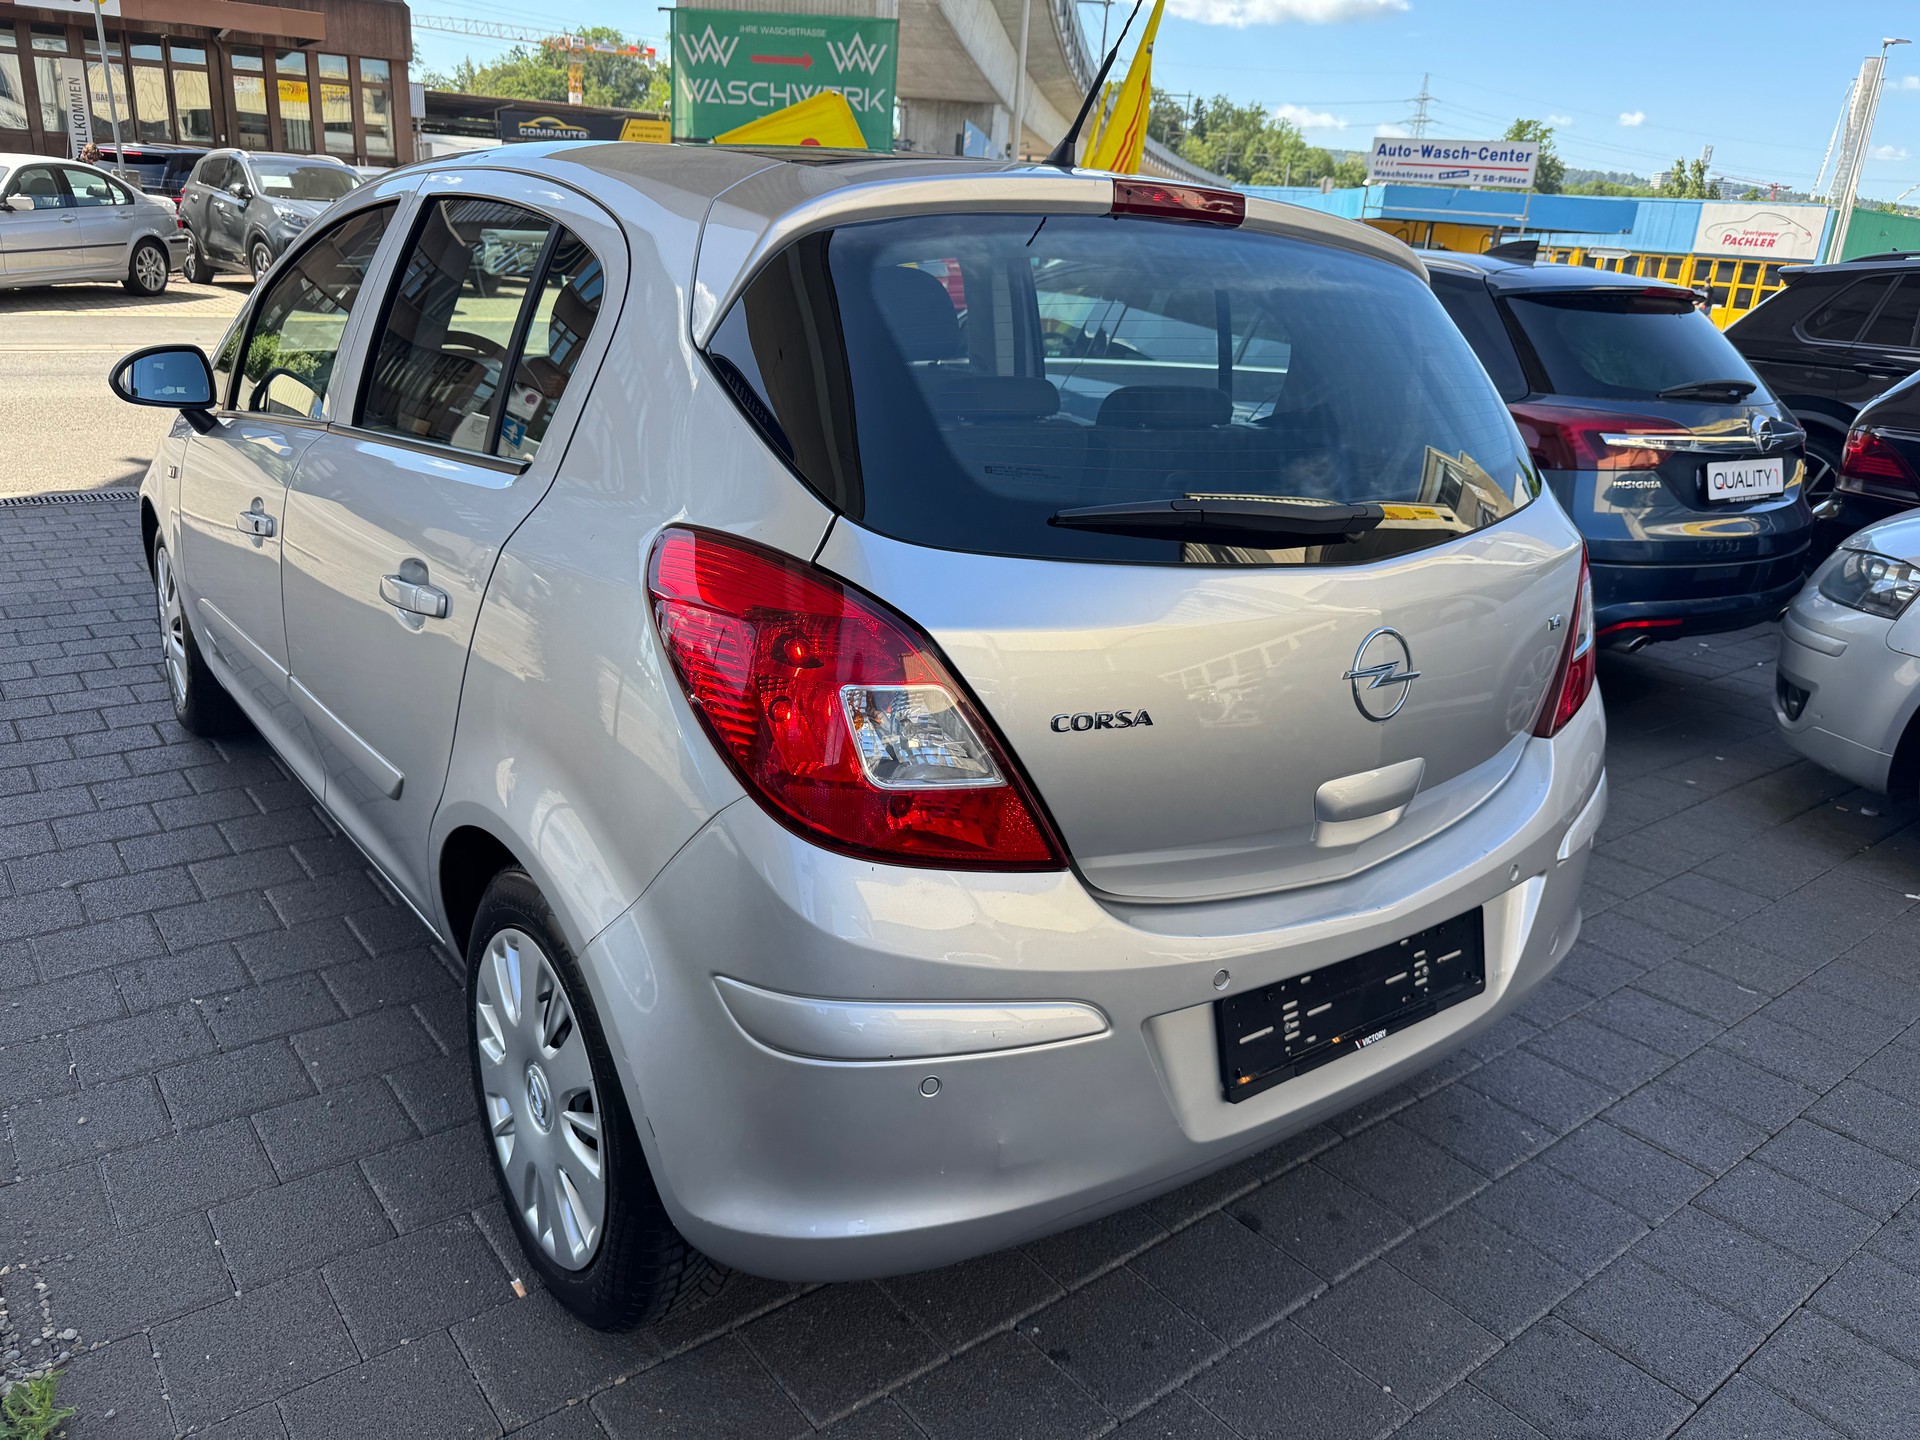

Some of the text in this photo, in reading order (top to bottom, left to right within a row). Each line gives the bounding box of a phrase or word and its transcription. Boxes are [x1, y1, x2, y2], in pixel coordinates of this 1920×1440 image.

[740, 25, 827, 38] IHRE WASCHSTRASSE
[680, 77, 886, 114] WASCHWRK
[519, 127, 588, 140] COMPAUTO
[1377, 143, 1533, 163] Auto-Wasch-Center
[1374, 169, 1435, 179] Waschstrasse
[1721, 234, 1776, 248] PACHLER
[1050, 709, 1153, 732] CORSA
